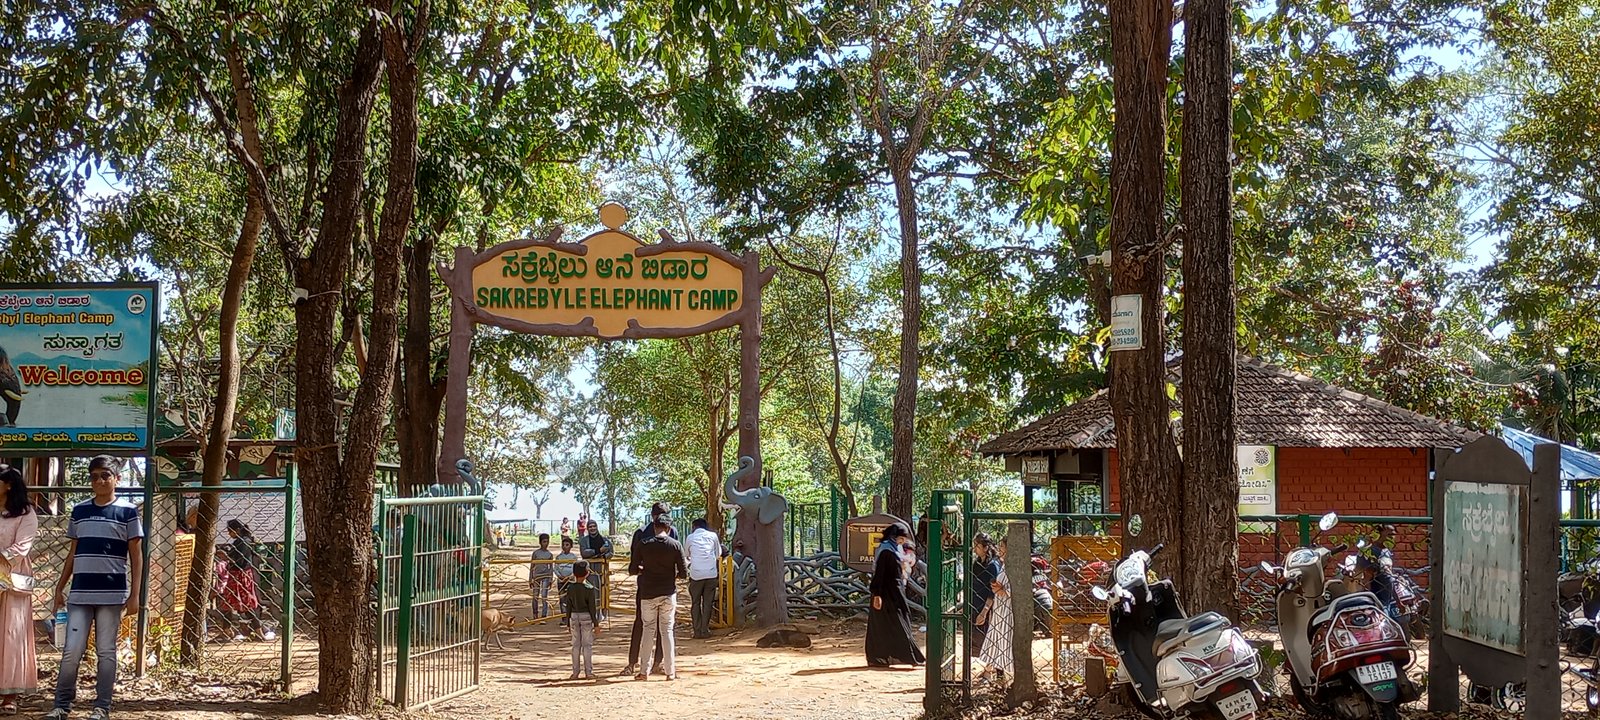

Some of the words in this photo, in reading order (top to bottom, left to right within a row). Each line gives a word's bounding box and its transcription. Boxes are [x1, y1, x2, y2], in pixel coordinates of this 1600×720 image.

[596, 253, 634, 279] ಆನೆ
[641, 255, 709, 280] ಬಿಡಾರ
[36, 295, 54, 305] ಆನೆ
[477, 286, 587, 310] SAKREBYLE
[590, 287, 684, 311] ELEPHANT
[687, 289, 739, 311] CAMP
[23, 313, 76, 326] Elephant
[79, 313, 114, 325] Camp
[43, 332, 123, 357] ಸುಸ್ವಾಗತ
[19, 365, 144, 384] Welcome
[860, 555, 875, 563] PAR
